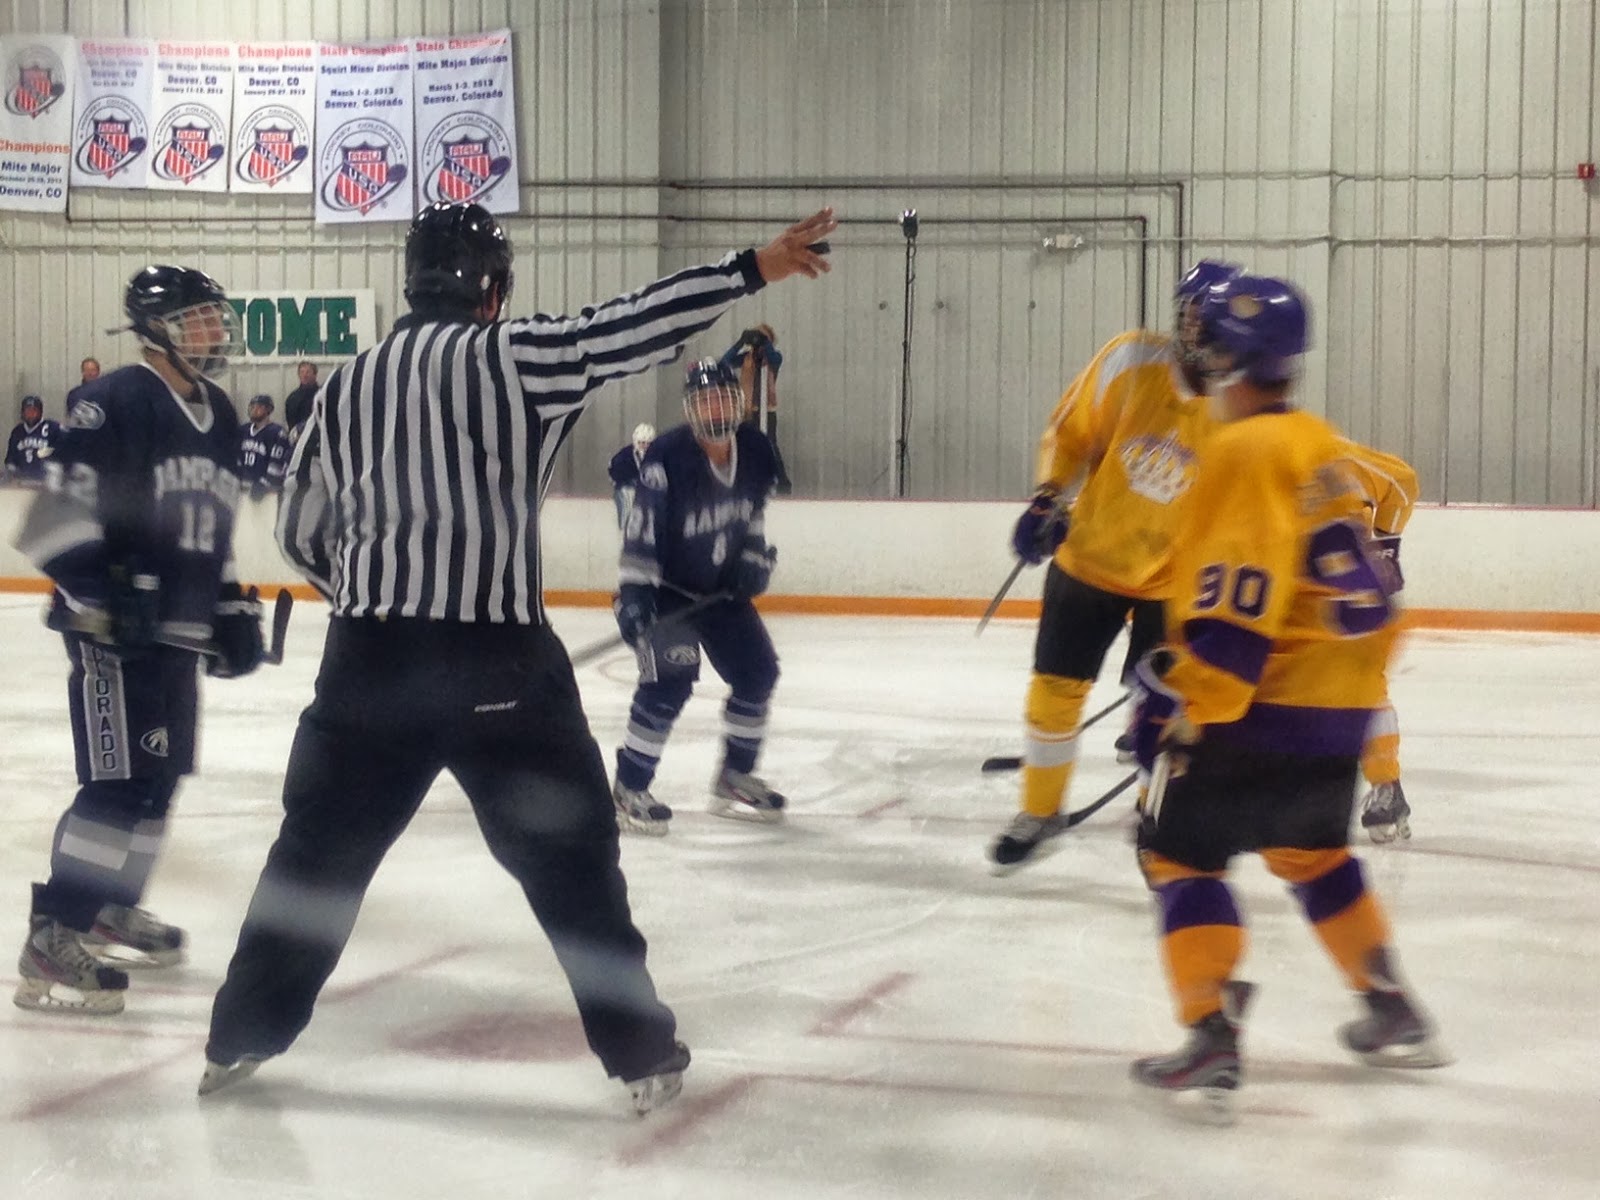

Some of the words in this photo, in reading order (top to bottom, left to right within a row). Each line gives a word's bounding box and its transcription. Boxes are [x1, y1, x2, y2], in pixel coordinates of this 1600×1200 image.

[81, 43, 150, 58] Champions
[158, 43, 230, 59] Champions
[238, 45, 312, 60] Champions
[416, 41, 444, 53] State
[418, 61, 438, 70] Mite
[441, 60, 467, 70] Major
[470, 55, 508, 66] Division
[238, 64, 254, 73] Mite
[258, 64, 279, 75] Major
[282, 64, 314, 73] Division
[321, 66, 347, 76] Squirt
[350, 65, 374, 74] Minor
[377, 63, 410, 72] Division
[205, 76, 217, 86] CO
[287, 77, 299, 87] CO
[473, 79, 494, 88] 2013
[330, 89, 354, 97] March
[374, 87, 394, 96] 2013
[462, 89, 503, 101] Colorado
[363, 97, 403, 107] Colorado
[1, 161, 28, 172] Mite
[31, 162, 62, 175] Major
[46, 187, 62, 198] CO
[41, 423, 49, 438] C
[244, 451, 256, 467] 10
